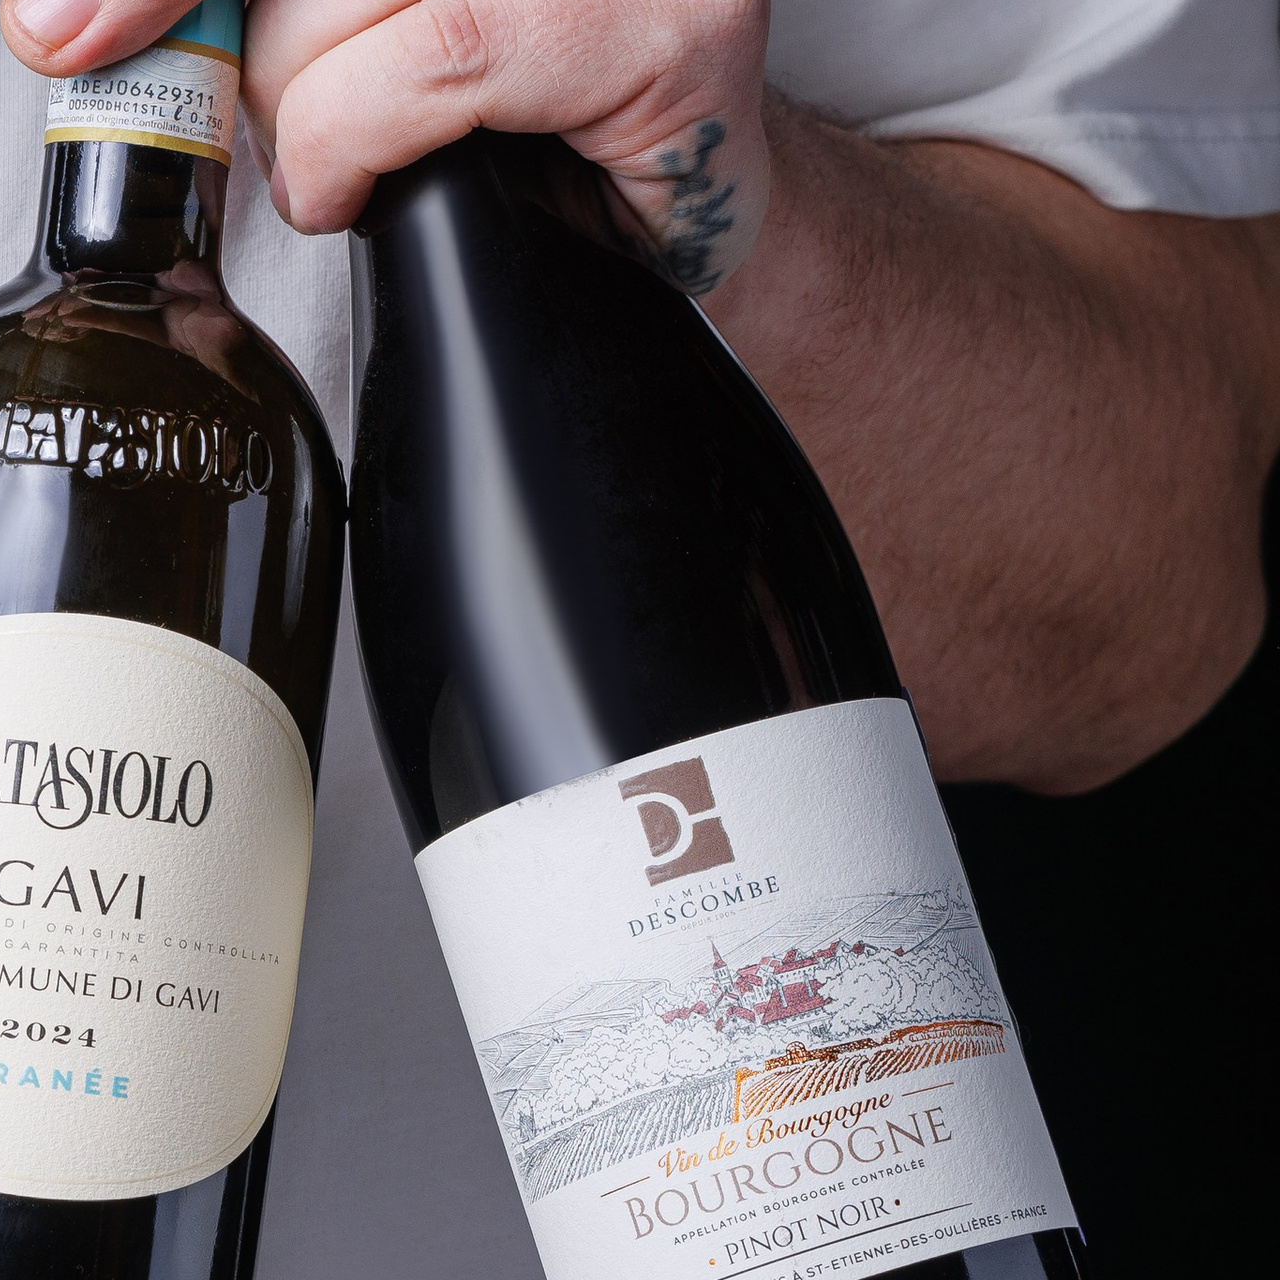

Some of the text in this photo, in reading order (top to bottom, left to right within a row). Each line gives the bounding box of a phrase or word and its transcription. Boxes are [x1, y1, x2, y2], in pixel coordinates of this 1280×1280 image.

[71, 80, 214, 110] ADEJ06429311
[86, 114, 94, 122] di
[96, 115, 130, 126] Origine
[132, 117, 180, 134] Controllata
[190, 112, 222, 130] 0.750
[628, 876, 780, 937] DESCOMBE
[654, 872, 744, 906] FAMILLE
[4, 918, 26, 930] DI
[46, 922, 146, 944] ORIGINE
[164, 937, 279, 965] CONTROLLATA
[4, 939, 140, 964] GARANTITA
[110, 976, 142, 1003] DI
[156, 982, 220, 1014] GAVI
[0, 1019, 97, 1048] 2024
[658, 1092, 894, 1178] Vin de Bourgogne
[624, 1106, 953, 1240] BOURGOGNE
[673, 1159, 926, 1246] APPELLATION BOURGOGNE CONTRÔLÉE
[724, 1195, 890, 1266] PINOT NOIR
[806, 1214, 1002, 1278] ST-ETIENNE-DES-OULLIÈRES
[1011, 1204, 1048, 1221] FRANCE
